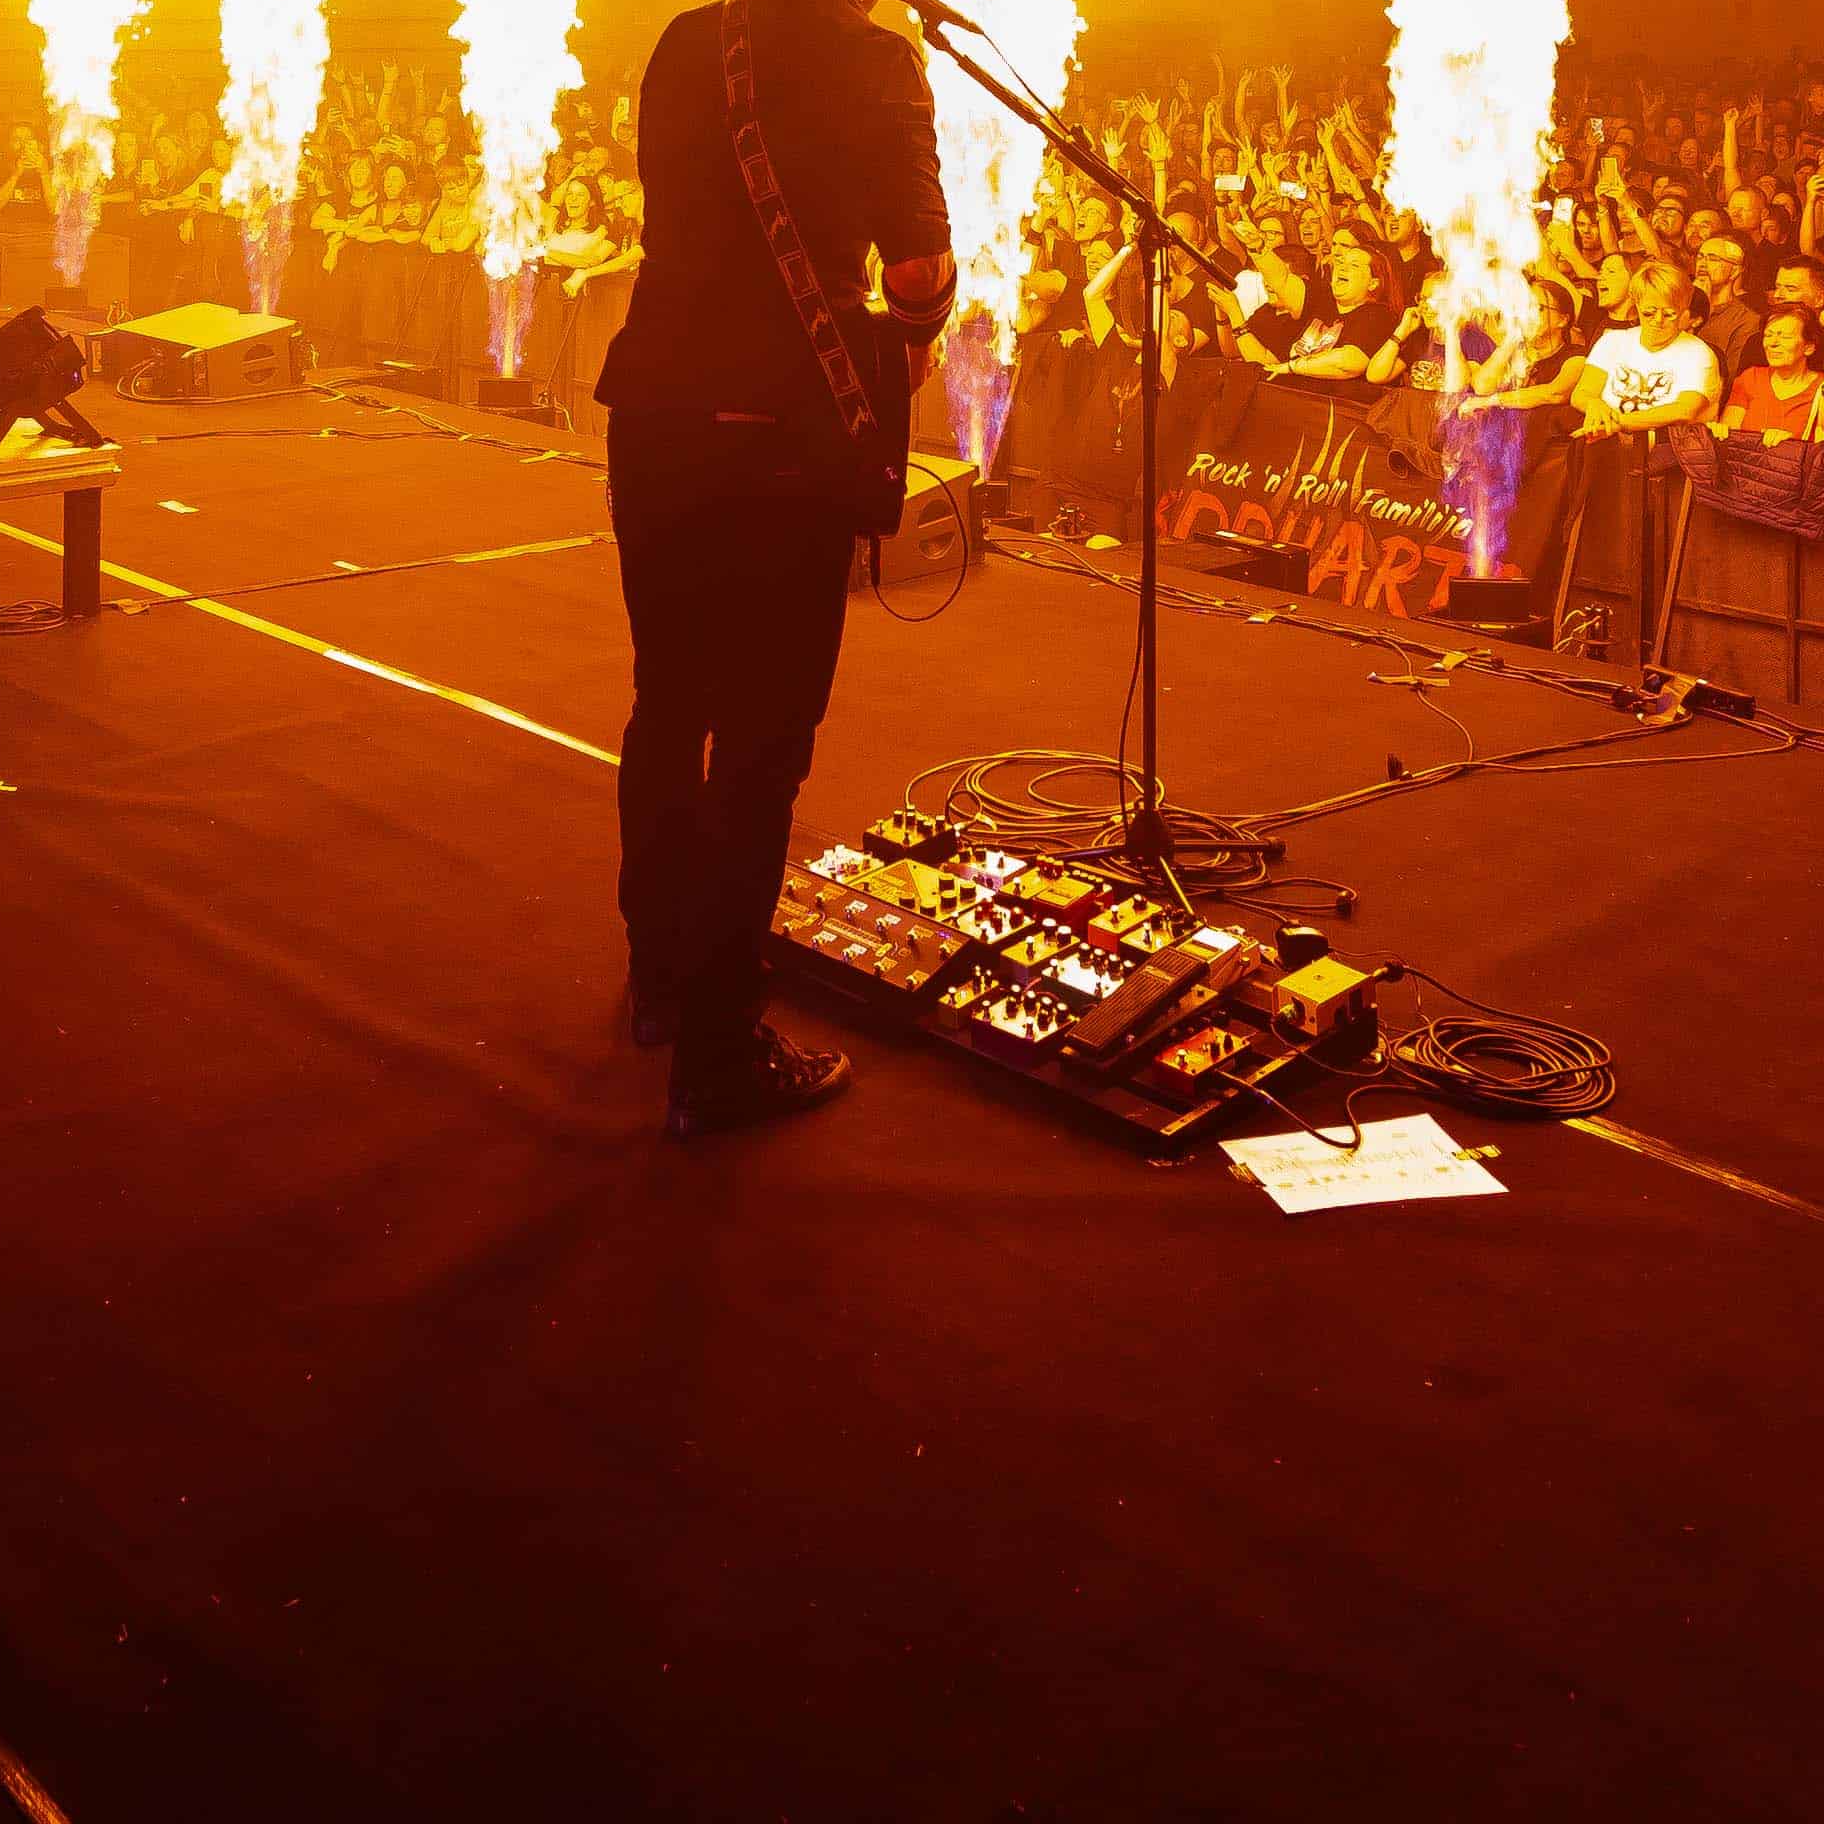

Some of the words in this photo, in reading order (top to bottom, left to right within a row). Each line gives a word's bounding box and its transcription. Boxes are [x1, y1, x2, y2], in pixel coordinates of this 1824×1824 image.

[1186, 453, 1252, 489] Rock
[1263, 465, 1290, 493] 'n'
[1294, 474, 1349, 507] Roll
[1354, 488, 1473, 544] Familija
